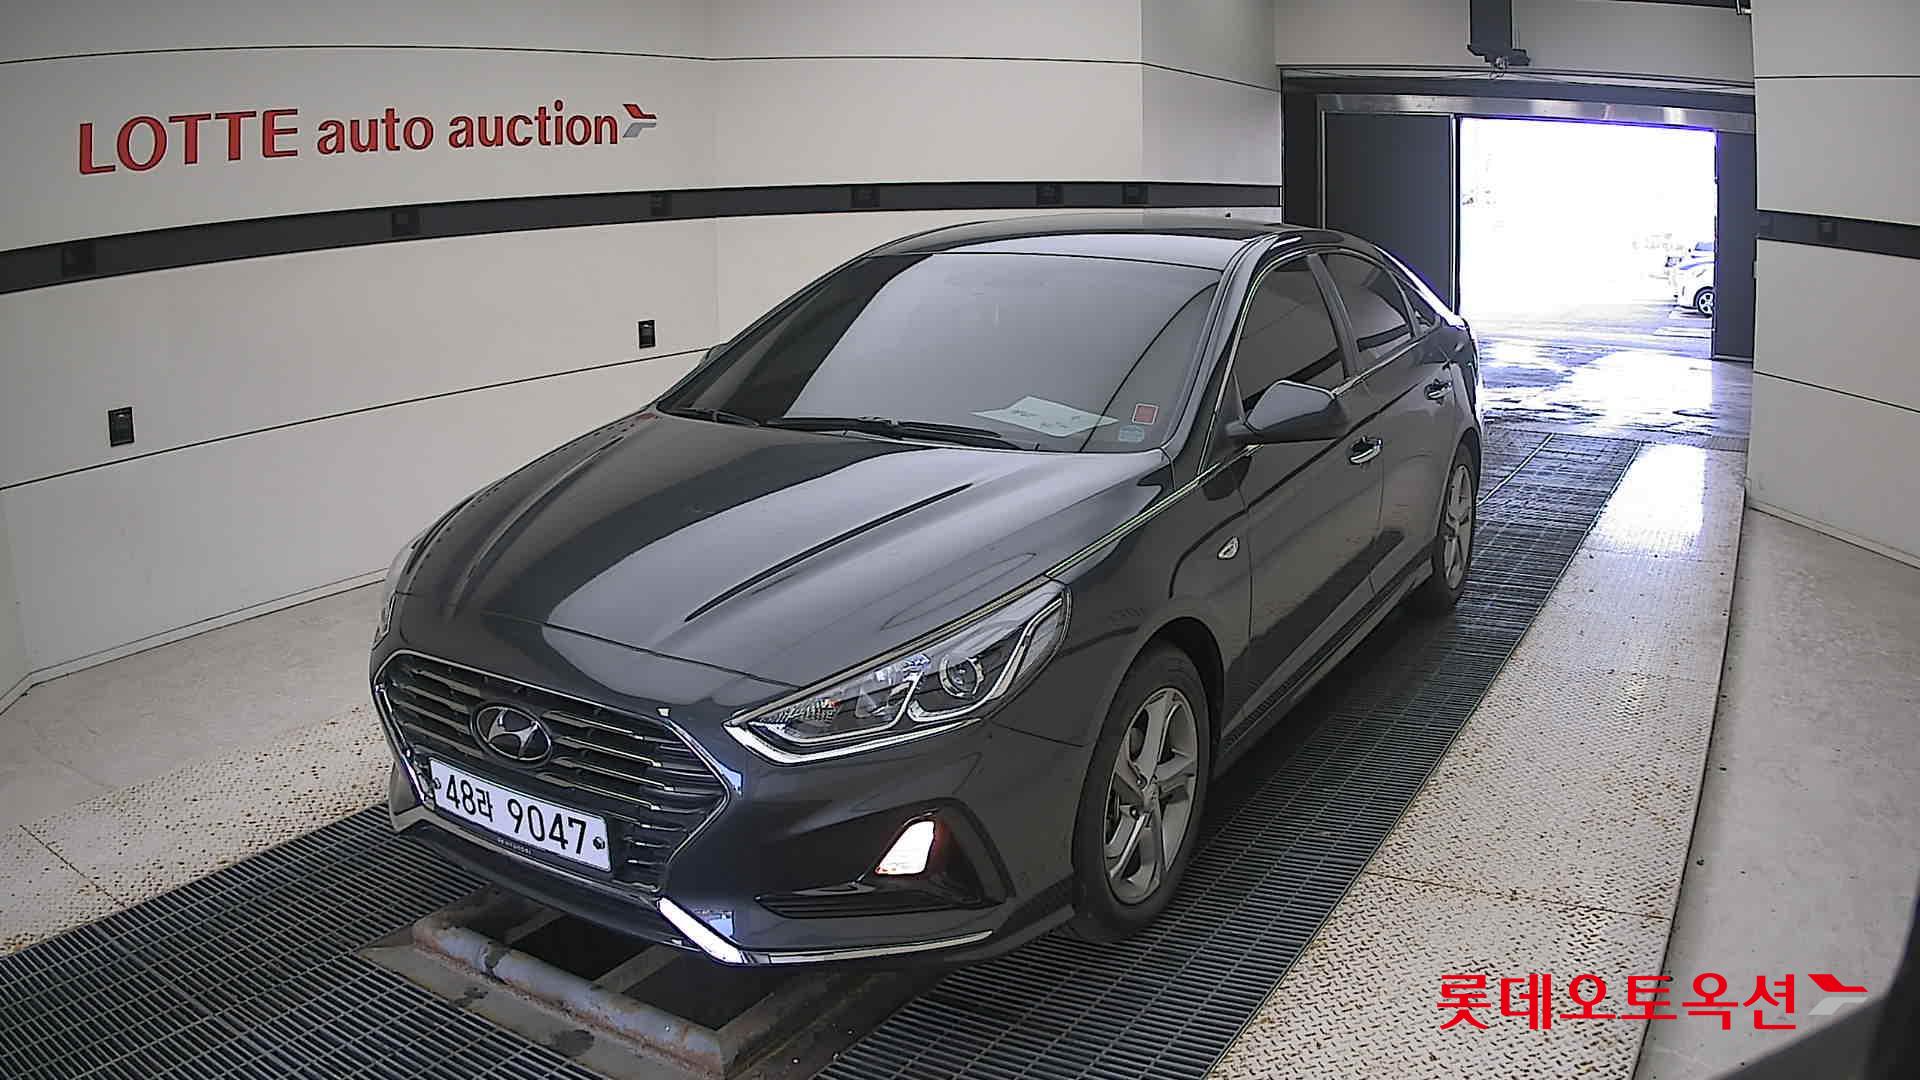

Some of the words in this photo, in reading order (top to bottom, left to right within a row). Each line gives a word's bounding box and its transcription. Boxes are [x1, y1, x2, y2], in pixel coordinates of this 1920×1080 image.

[79, 108, 298, 175] LOTTE
[316, 107, 434, 155] auto
[448, 100, 618, 149] auction
[446, 774, 494, 822] 48라
[507, 798, 587, 855] 9047
